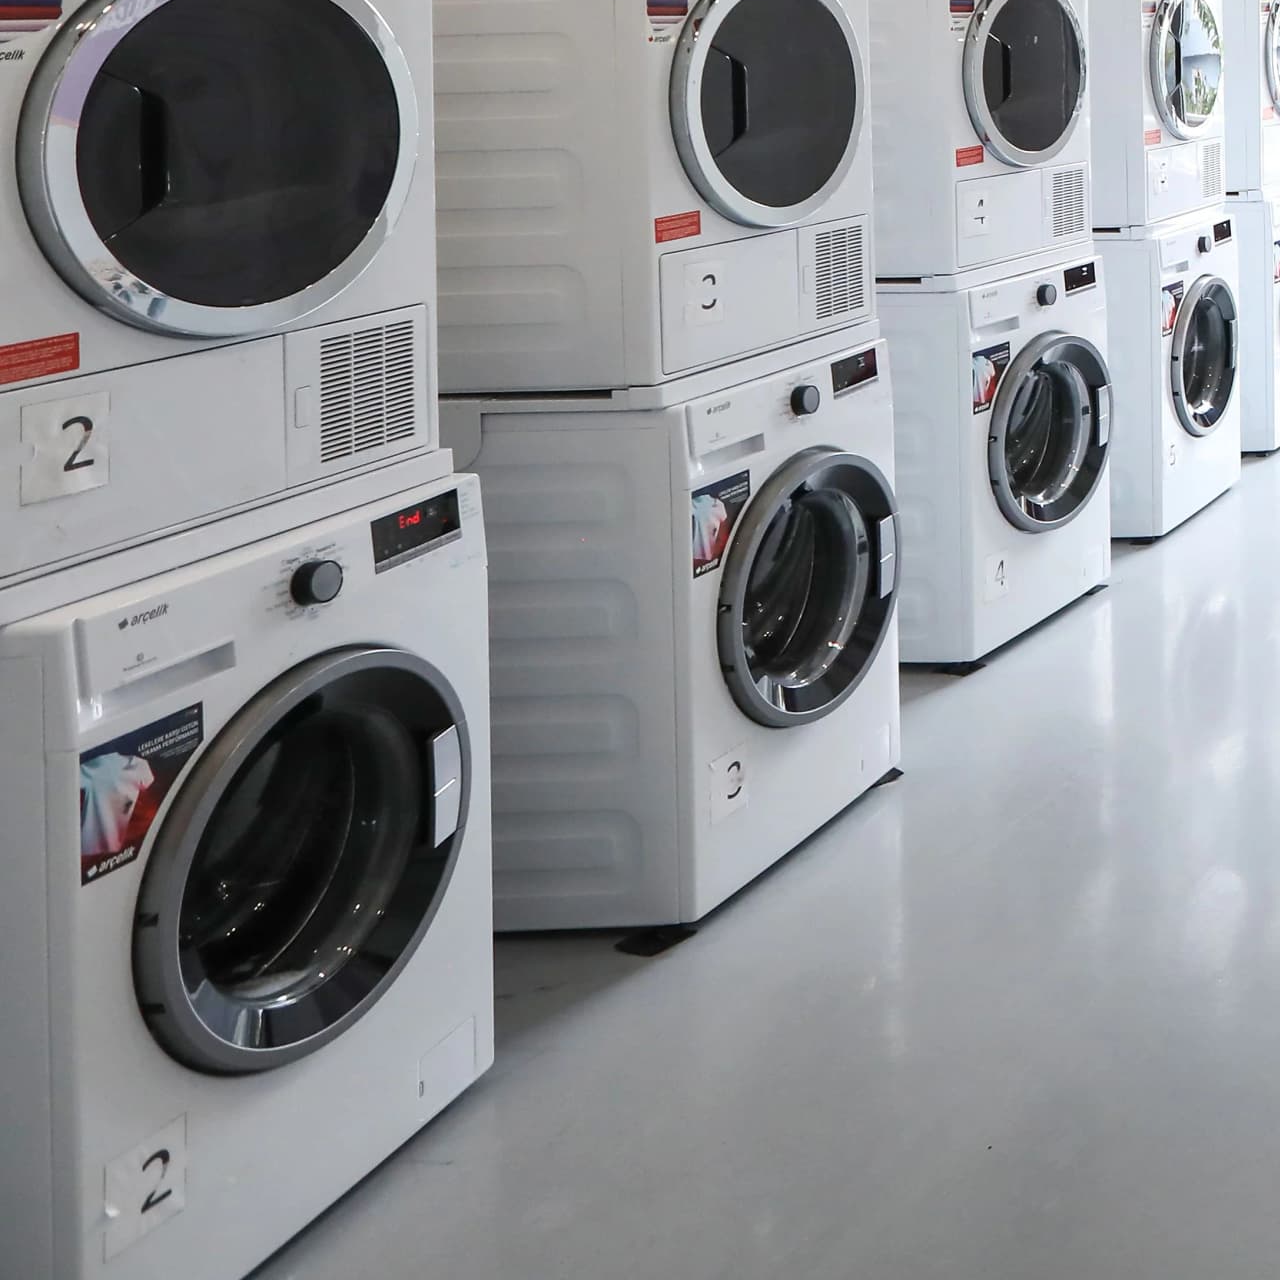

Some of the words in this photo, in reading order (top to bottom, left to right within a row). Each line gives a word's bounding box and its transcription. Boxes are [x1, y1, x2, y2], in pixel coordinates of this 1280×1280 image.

[61, 414, 96, 473] 2
[397, 508, 422, 529] End
[140, 1148, 172, 1214] 2
